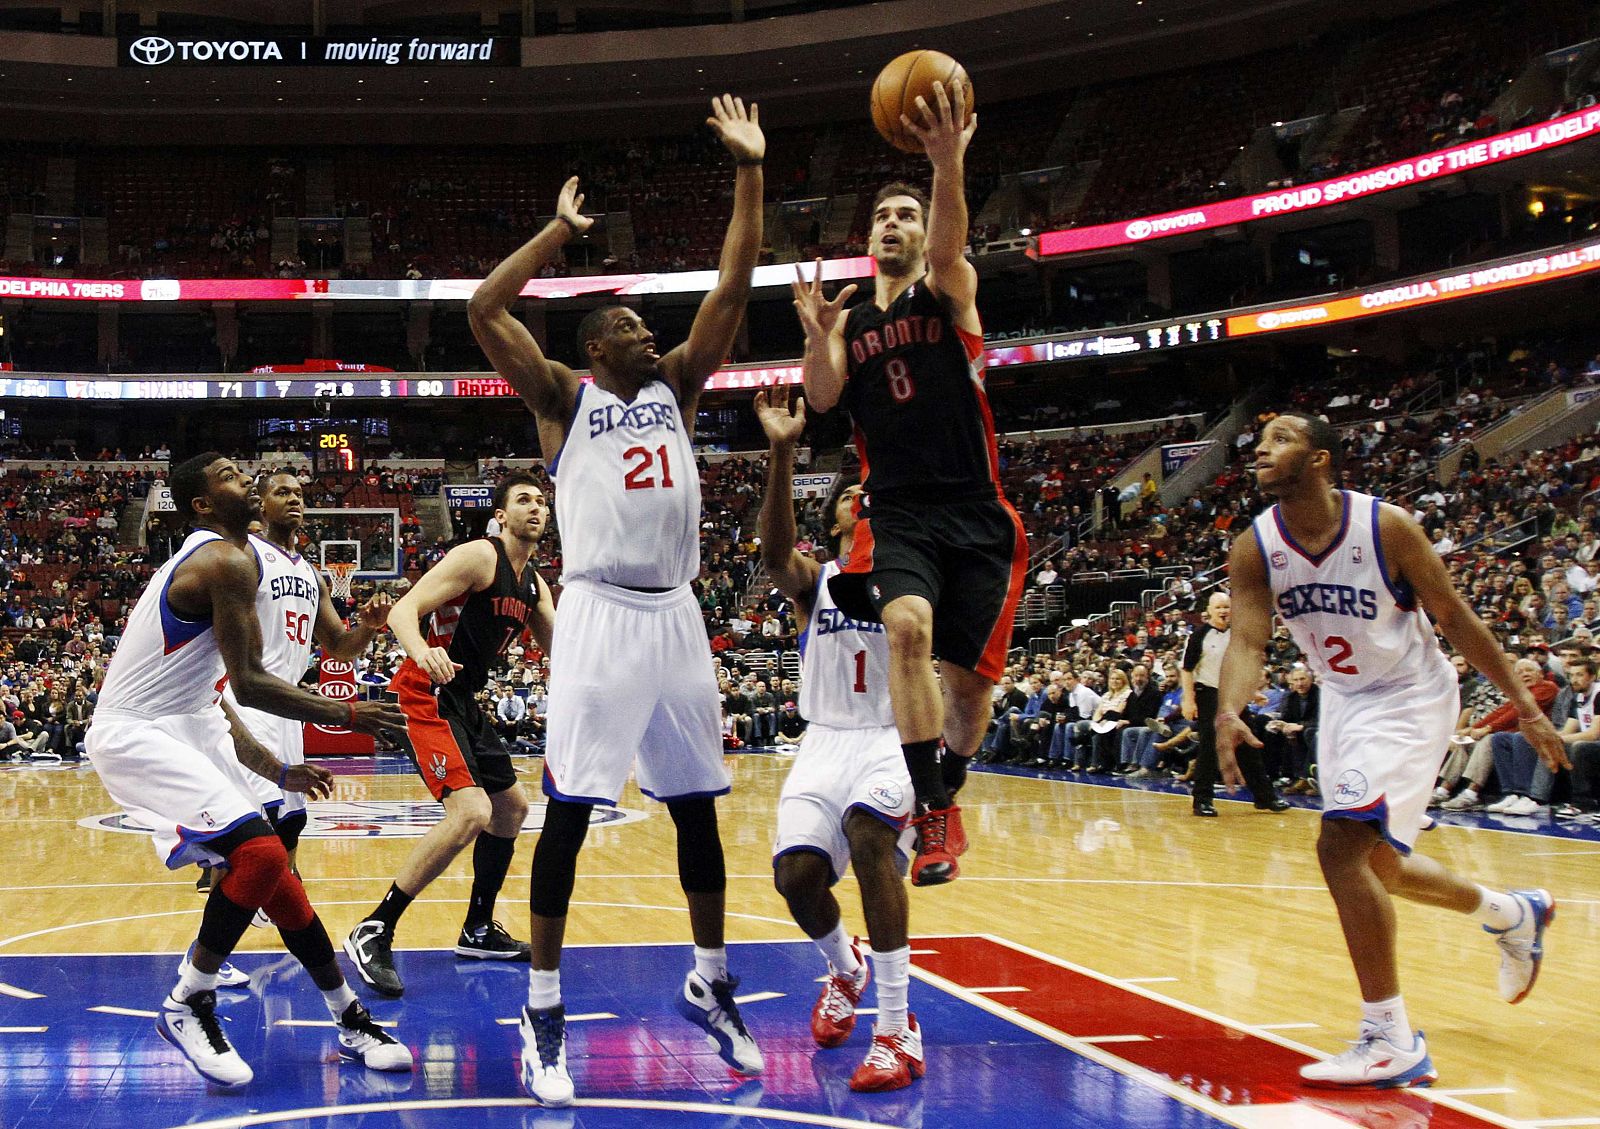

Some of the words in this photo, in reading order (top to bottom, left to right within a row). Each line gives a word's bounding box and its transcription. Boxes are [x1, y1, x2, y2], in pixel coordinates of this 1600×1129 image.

[178, 41, 283, 60] TOYOTA
[325, 38, 402, 65] moving
[408, 38, 493, 61] forward
[1150, 211, 1206, 233] TOYOTA
[1252, 188, 1321, 215] PROUD
[1324, 164, 1414, 201] SPONSOR
[1416, 156, 1444, 177] OF
[1448, 143, 1488, 169] THE
[1437, 273, 1472, 294] THE
[1472, 258, 1549, 285] WORLD'S
[73, 283, 124, 298] 76ERS
[852, 316, 941, 363] ORONTO
[219, 381, 243, 397] 71
[417, 380, 443, 397] 80
[458, 381, 518, 397] RAPTO
[887, 359, 915, 403] 8
[589, 402, 676, 439] SIXERS
[339, 449, 353, 471] 7
[623, 444, 674, 490] 21
[792, 477, 831, 486] GEICO
[448, 498, 462, 507] 119
[478, 498, 492, 507] 118
[451, 488, 489, 497] GEICO
[793, 489, 803, 497] 18
[1278, 583, 1377, 620] SIXERS
[286, 609, 309, 645] 50
[326, 661, 348, 671] KIA
[854, 650, 867, 693] 1
[325, 685, 350, 696] KIA
